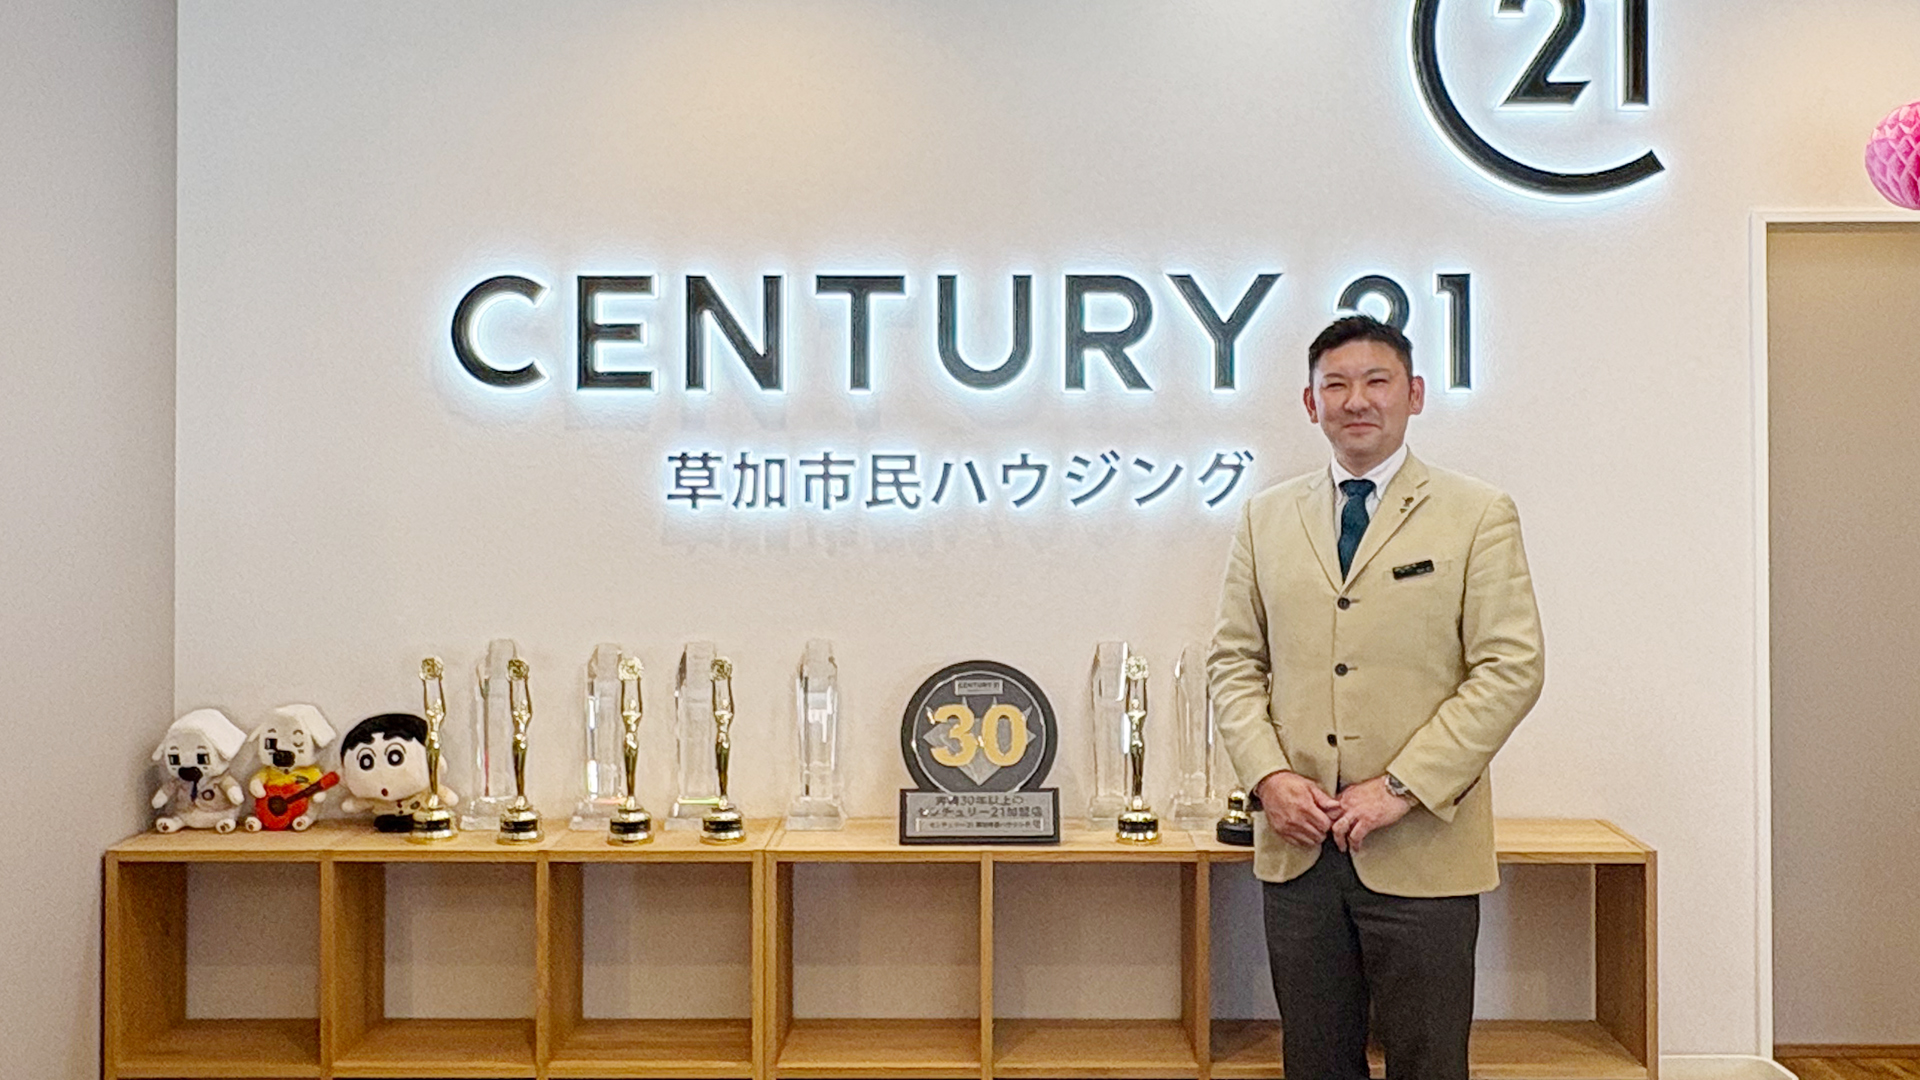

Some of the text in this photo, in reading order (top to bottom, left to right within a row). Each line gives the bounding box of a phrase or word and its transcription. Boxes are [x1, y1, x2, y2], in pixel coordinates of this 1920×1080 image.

[451, 273, 1284, 391] CENTURY
[667, 448, 1255, 511] 草加市民ハウジング
[930, 703, 1028, 767] 30
